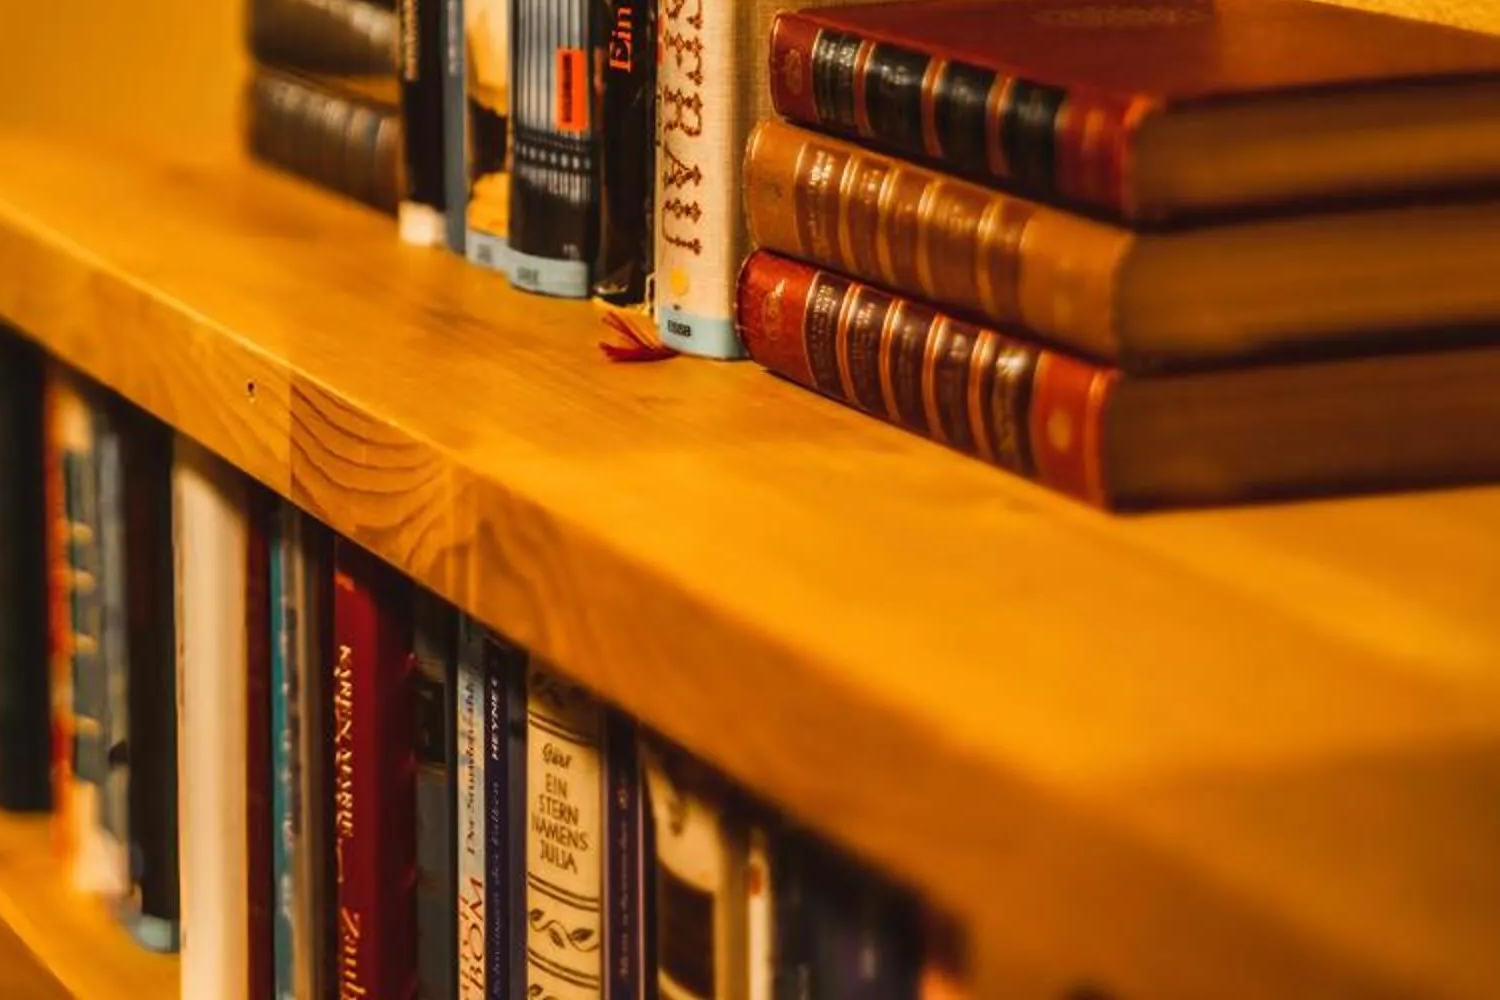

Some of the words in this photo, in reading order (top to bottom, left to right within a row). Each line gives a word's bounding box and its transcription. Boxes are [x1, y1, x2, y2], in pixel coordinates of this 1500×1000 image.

[609, 6, 633, 73] Ein
[545, 773, 568, 800] EIN
[539, 794, 580, 826] STERN
[531, 812, 590, 853] NAMENS
[539, 839, 578, 876] JULIA
